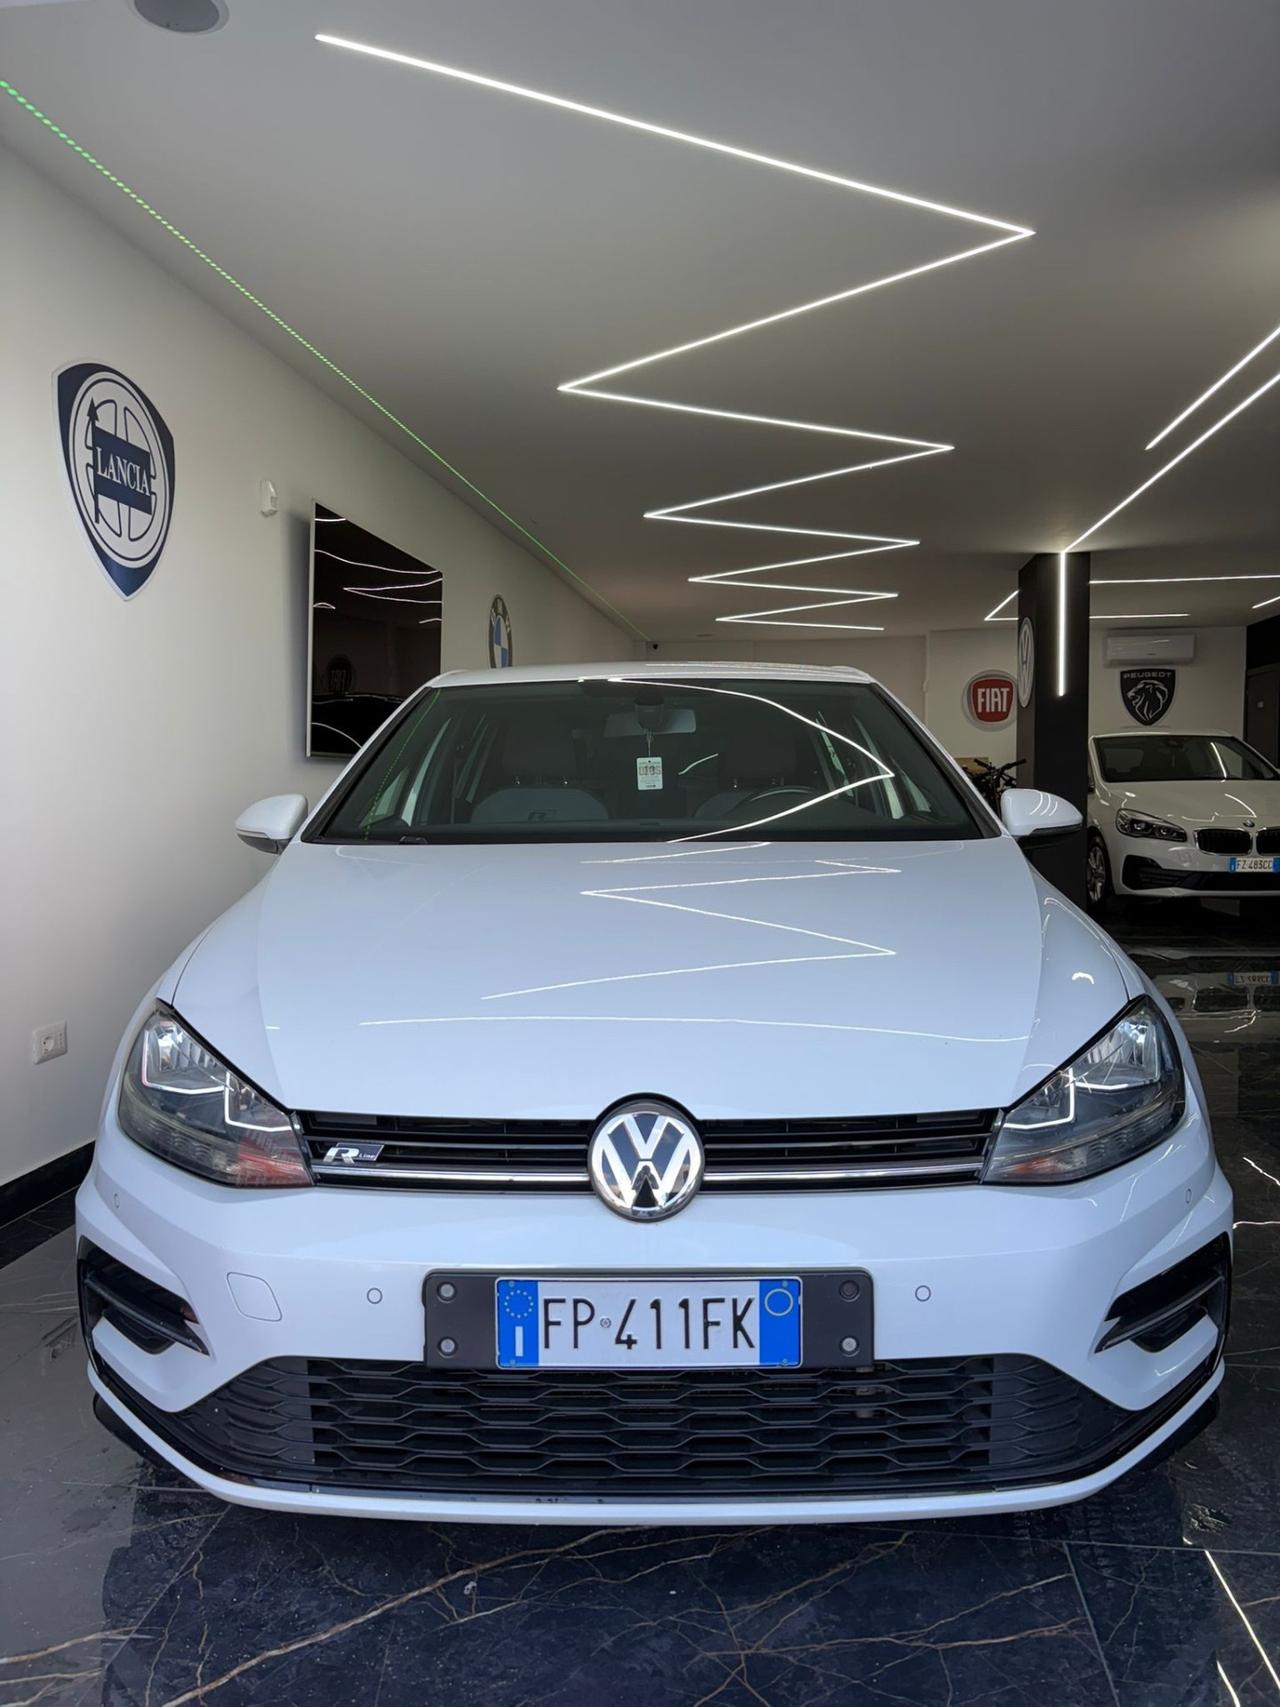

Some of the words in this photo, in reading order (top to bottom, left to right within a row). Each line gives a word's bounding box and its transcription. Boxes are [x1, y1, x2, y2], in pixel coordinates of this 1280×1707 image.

[95, 447, 151, 497] LANCIA
[1123, 671, 1172, 679] PEUGEOT
[977, 688, 1010, 713] FIAT
[323, 1147, 360, 1164] R
[543, 1298, 596, 1349] FP
[614, 1297, 756, 1349] 411FK
